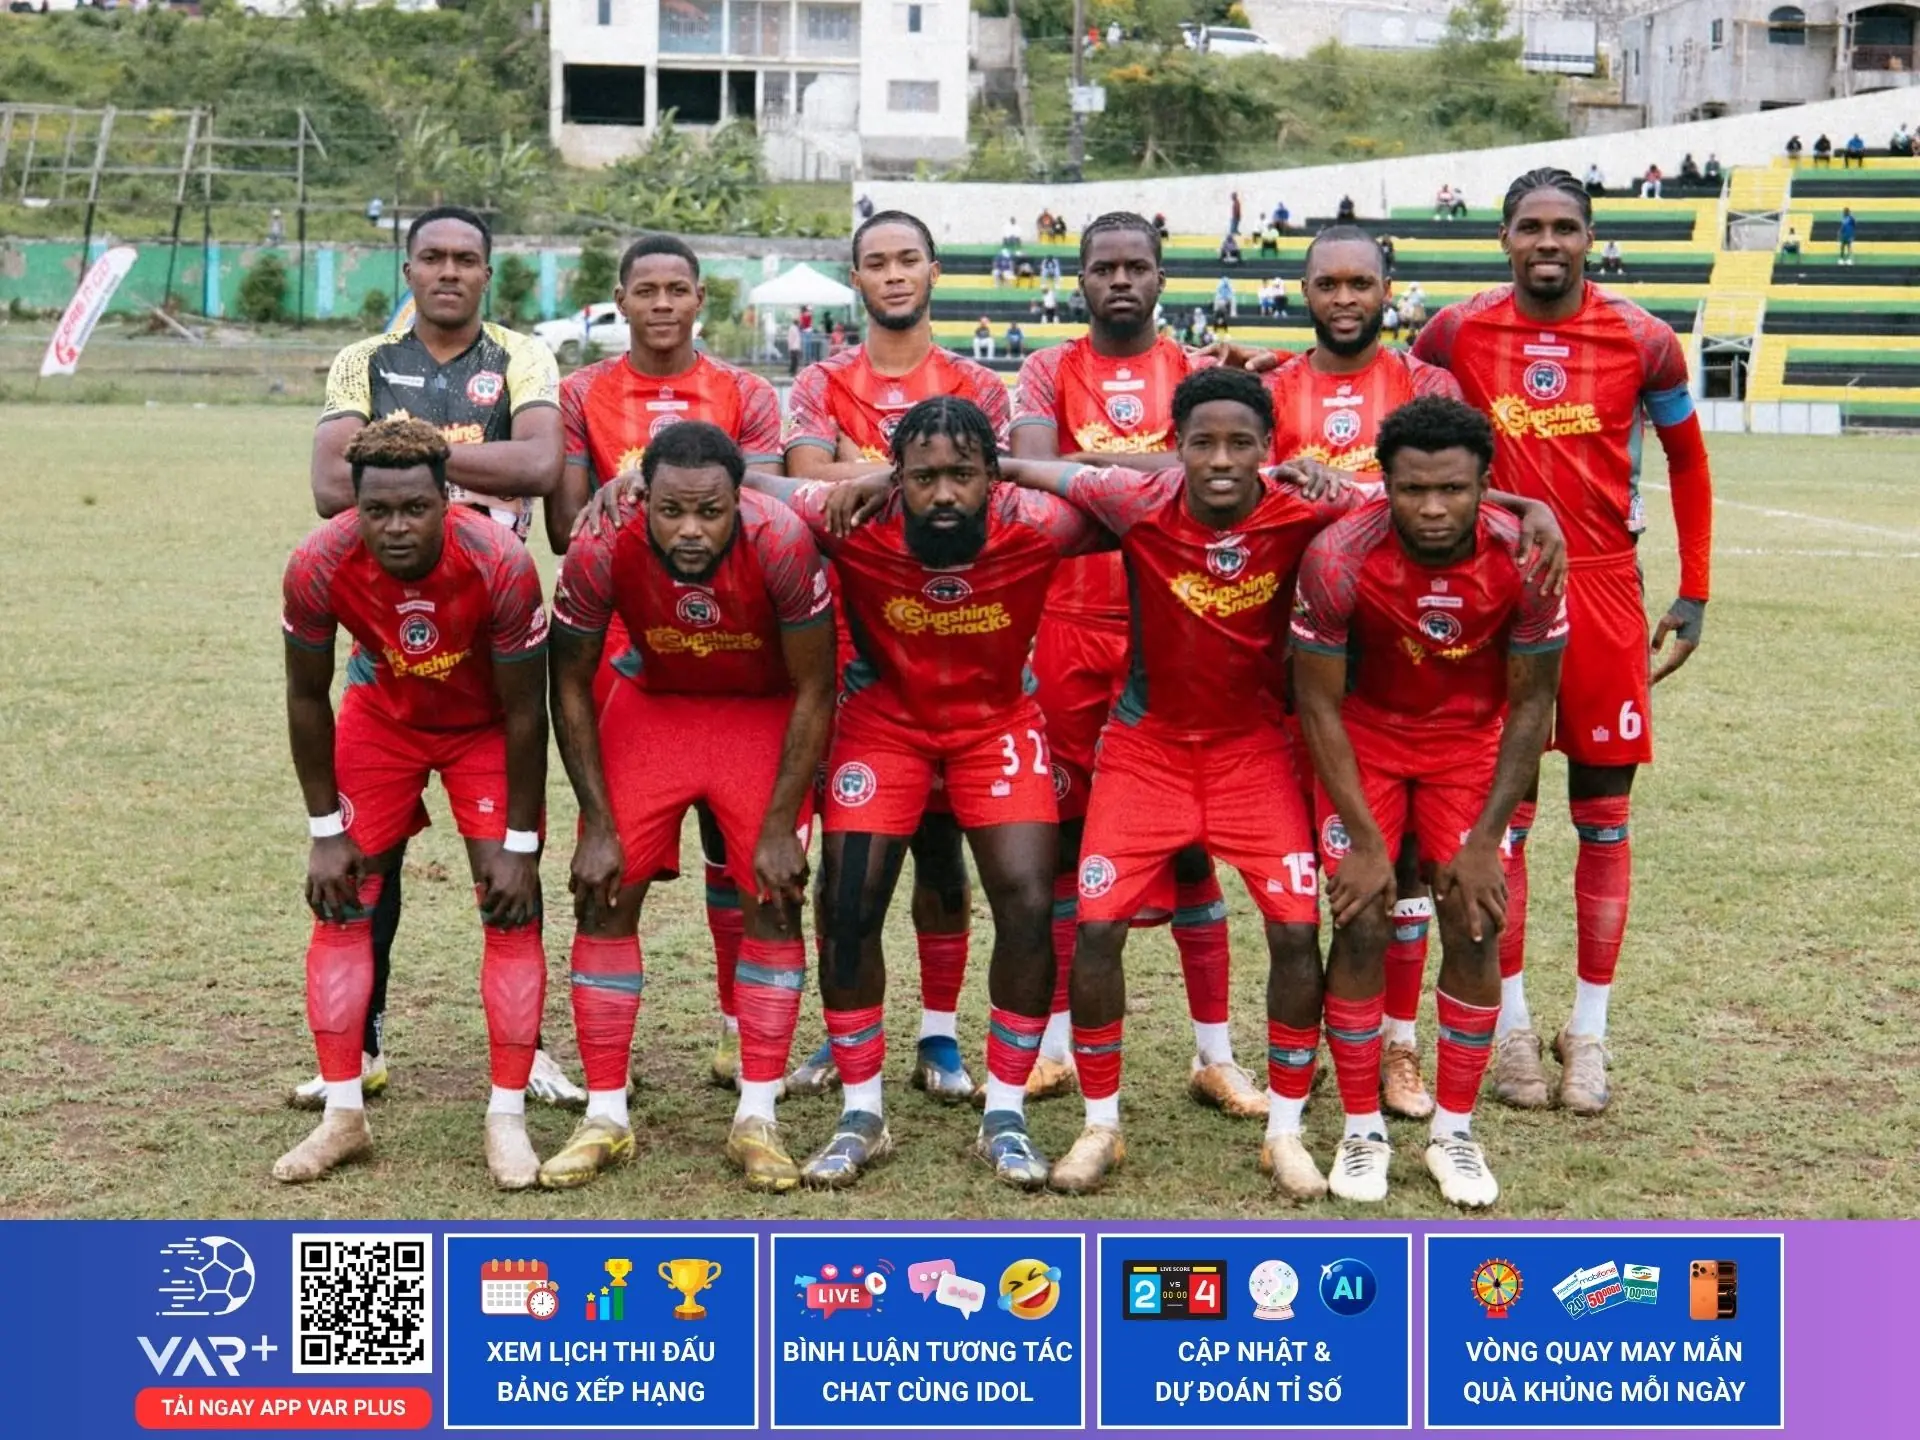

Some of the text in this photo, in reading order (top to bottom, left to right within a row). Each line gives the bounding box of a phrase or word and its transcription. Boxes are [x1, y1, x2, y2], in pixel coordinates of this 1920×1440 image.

[1508, 402, 1595, 429] Sunshine
[1534, 417, 1602, 438] Snacks
[1189, 572, 1276, 607] Sunshine
[903, 602, 1004, 627] Sunshine
[935, 612, 1012, 635] Snacks
[1619, 700, 1642, 740] 6
[999, 728, 1048, 776] 32
[1282, 852, 1319, 896] 15
